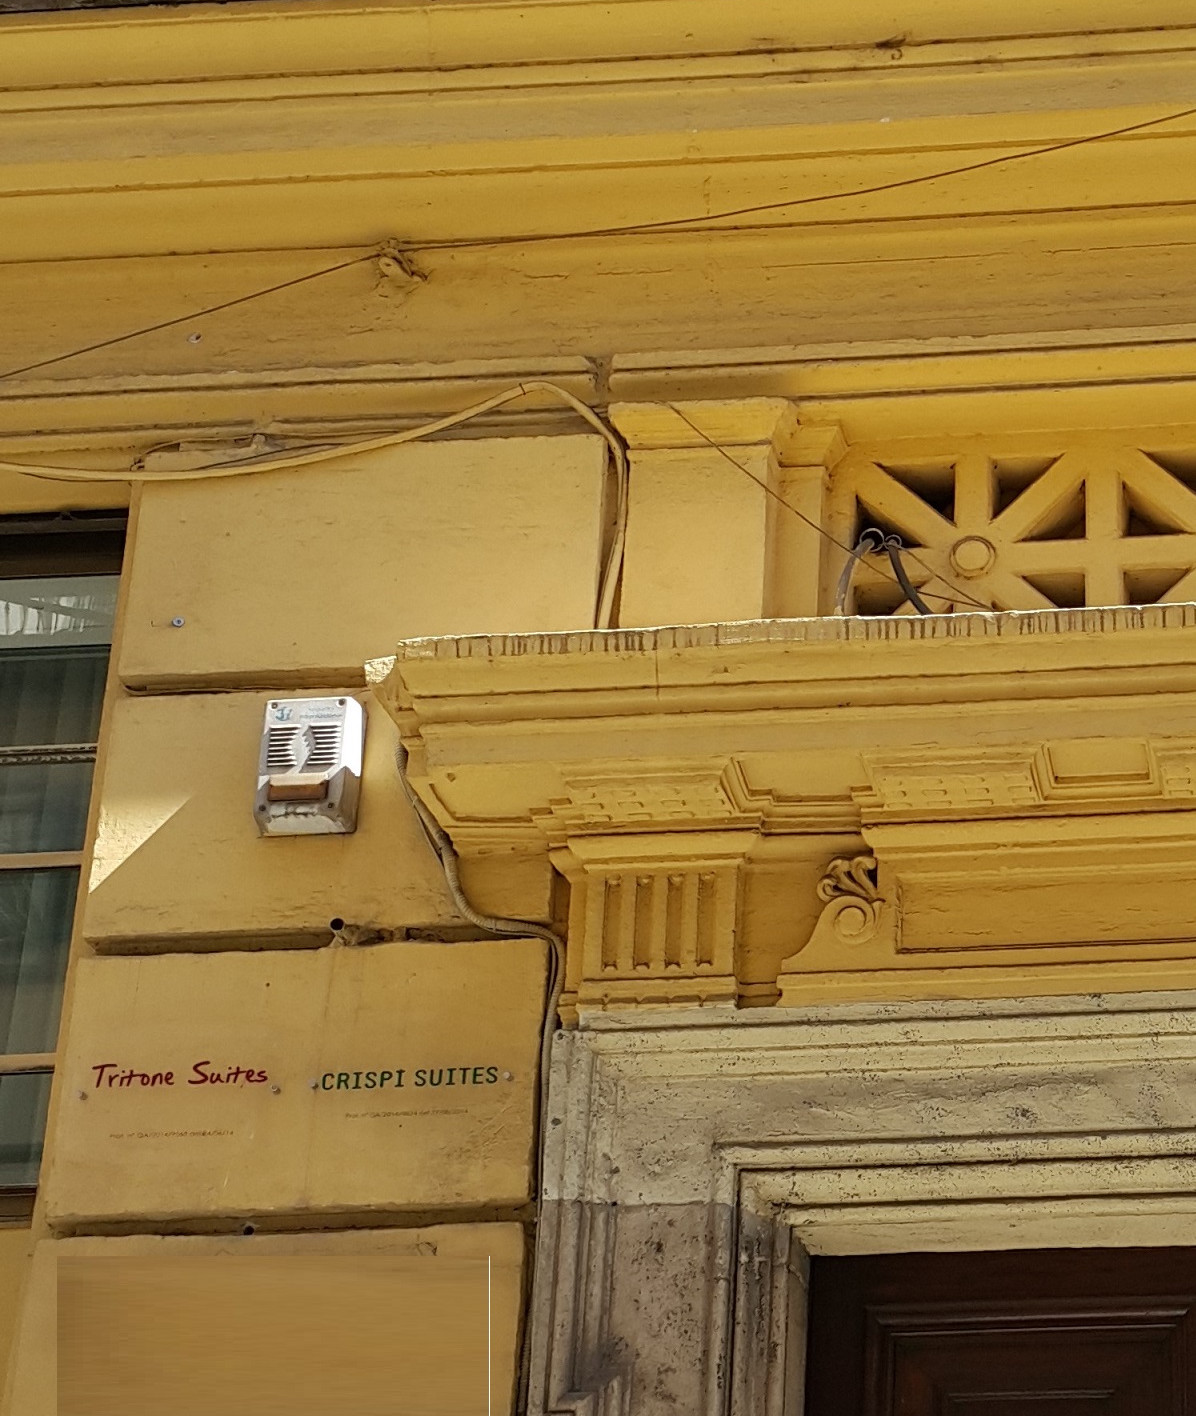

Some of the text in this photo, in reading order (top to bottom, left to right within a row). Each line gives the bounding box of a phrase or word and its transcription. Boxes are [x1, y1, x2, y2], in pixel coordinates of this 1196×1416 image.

[92, 1060, 269, 1088] Tritone Suites
[321, 1066, 499, 1091] CRISPI SUITES
